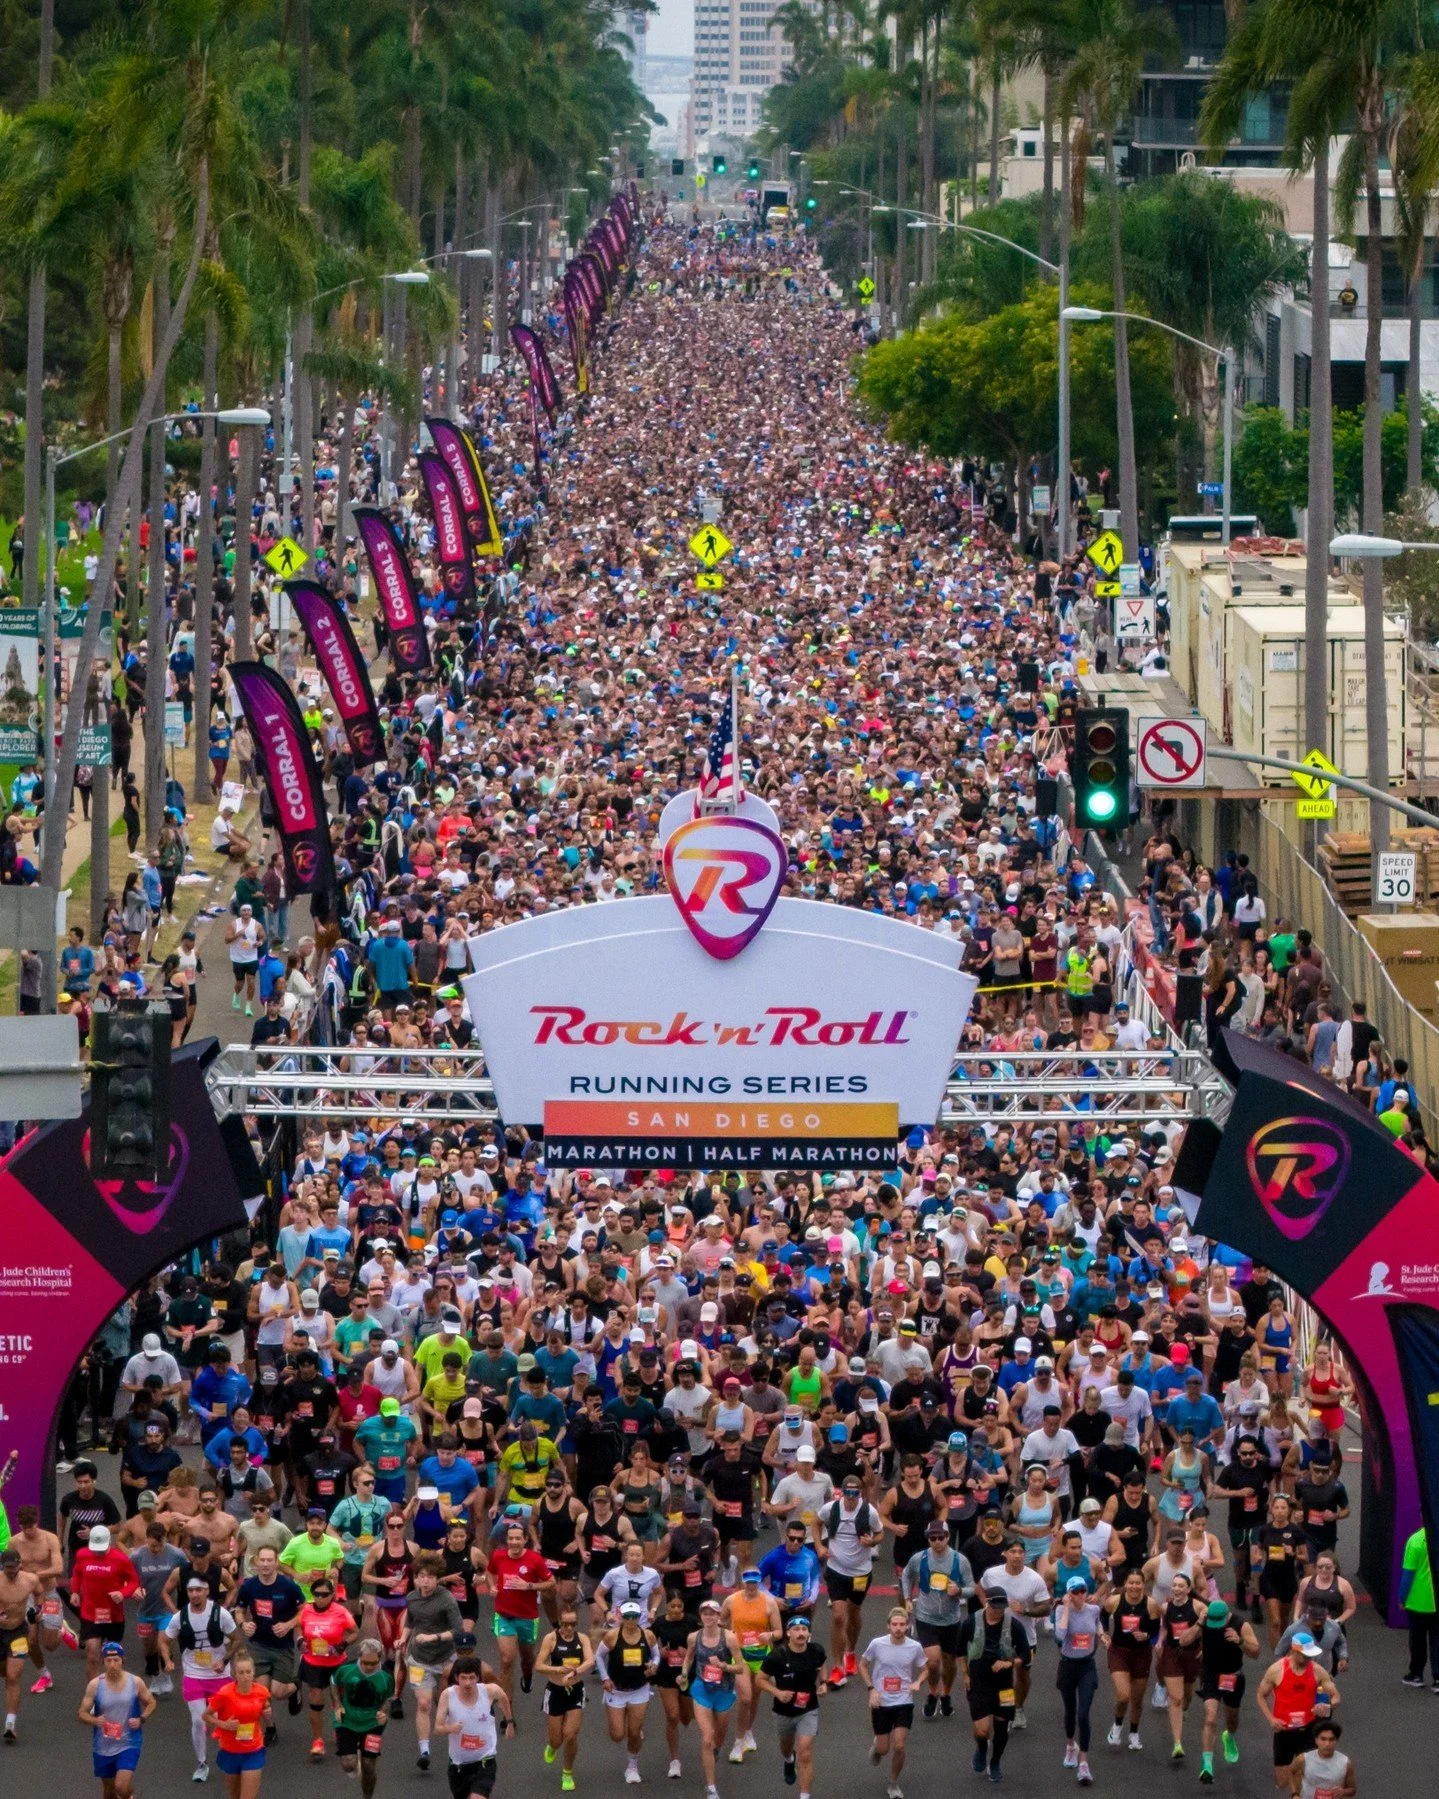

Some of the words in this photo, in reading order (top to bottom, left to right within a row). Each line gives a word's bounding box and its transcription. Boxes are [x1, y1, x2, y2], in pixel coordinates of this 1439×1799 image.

[446, 443, 456, 452] 5
[435, 482, 446, 492] 4
[451, 456, 475, 506] CORRAL
[442, 495, 457, 554] CORRAL
[376, 541, 388, 551] 3
[382, 557, 408, 621] CORRAL
[4, 614, 26, 622] YEARS
[26, 614, 37, 622] OF
[316, 616, 331, 630] 2
[324, 633, 359, 708] CORRAL
[264, 712, 280, 726] 1
[77, 744, 105, 752] USEUM
[274, 731, 307, 822] CORRAL
[1302, 804, 1330, 814] AHEAD
[1382, 857, 1413, 867] SPEED
[1384, 869, 1409, 877] LIMIT
[1382, 878, 1411, 897] 30
[570, 1075, 732, 1094] RUNNING
[743, 1075, 869, 1094] SERIES
[627, 1111, 691, 1128] SAN
[716, 1112, 821, 1129] DIEGO
[547, 1146, 677, 1160] MARATHON
[704, 1146, 761, 1161] HALF
[772, 1146, 897, 1161] MARATHON
[3, 1267, 23, 1277] Jude
[25, 1267, 71, 1276] Children's
[1413, 1264, 1432, 1275] Jude
[33, 1277, 72, 1289] Hospital
[1401, 1275, 1439, 1284] Research
[0, 1335, 33, 1351] ETIC
